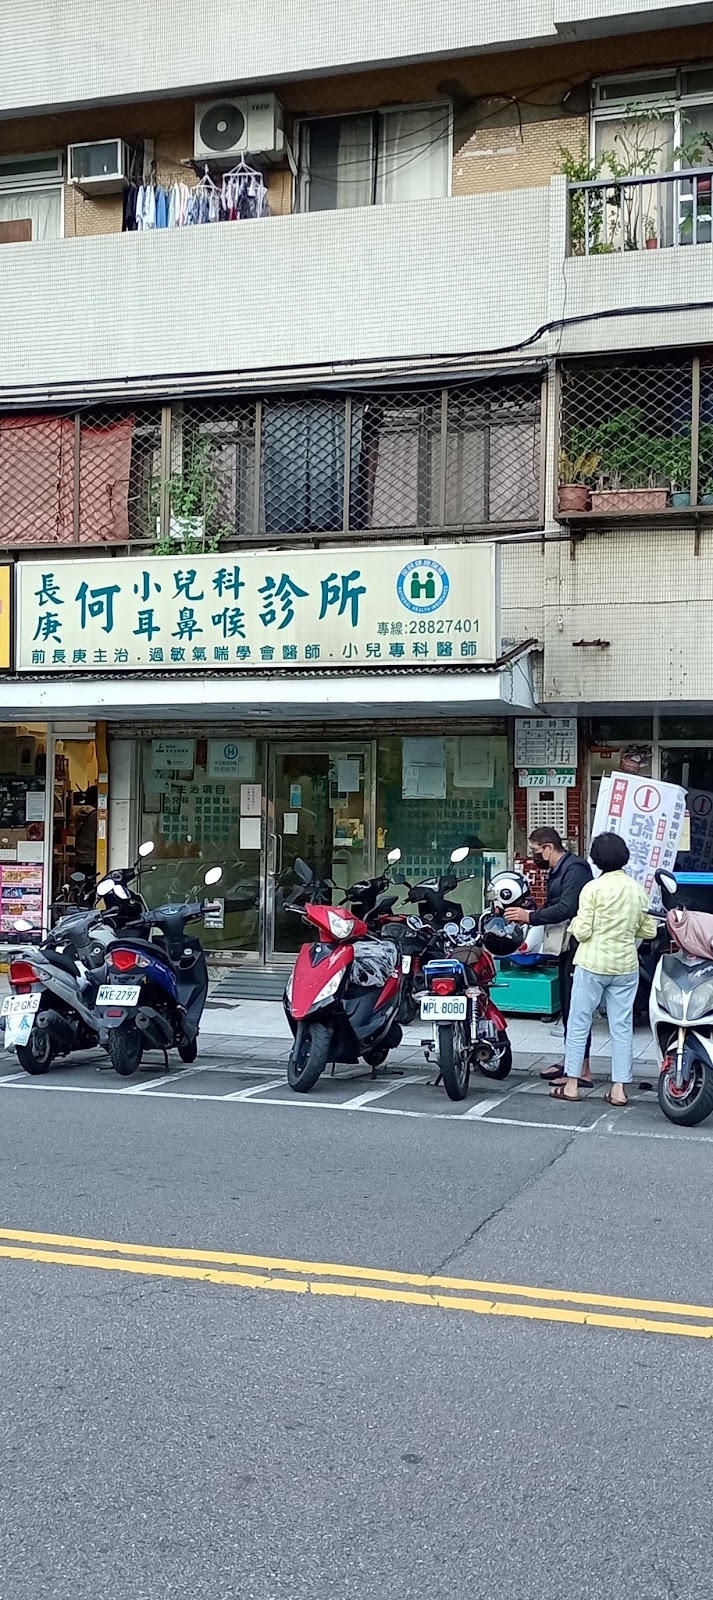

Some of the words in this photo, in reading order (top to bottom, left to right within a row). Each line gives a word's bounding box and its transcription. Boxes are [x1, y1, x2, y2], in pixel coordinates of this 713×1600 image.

[133, 566, 245, 602] 小兒科
[258, 570, 366, 629] 診所
[33, 573, 65, 643] 長庚
[75, 581, 121, 633] 何
[133, 607, 246, 642] 耳鼻喉
[523, 720, 569, 728] 門診時間
[178, 785, 225, 794] 主治項目
[99, 990, 137, 1001] MXE-2797
[423, 1002, 464, 1014] MPL-8080
